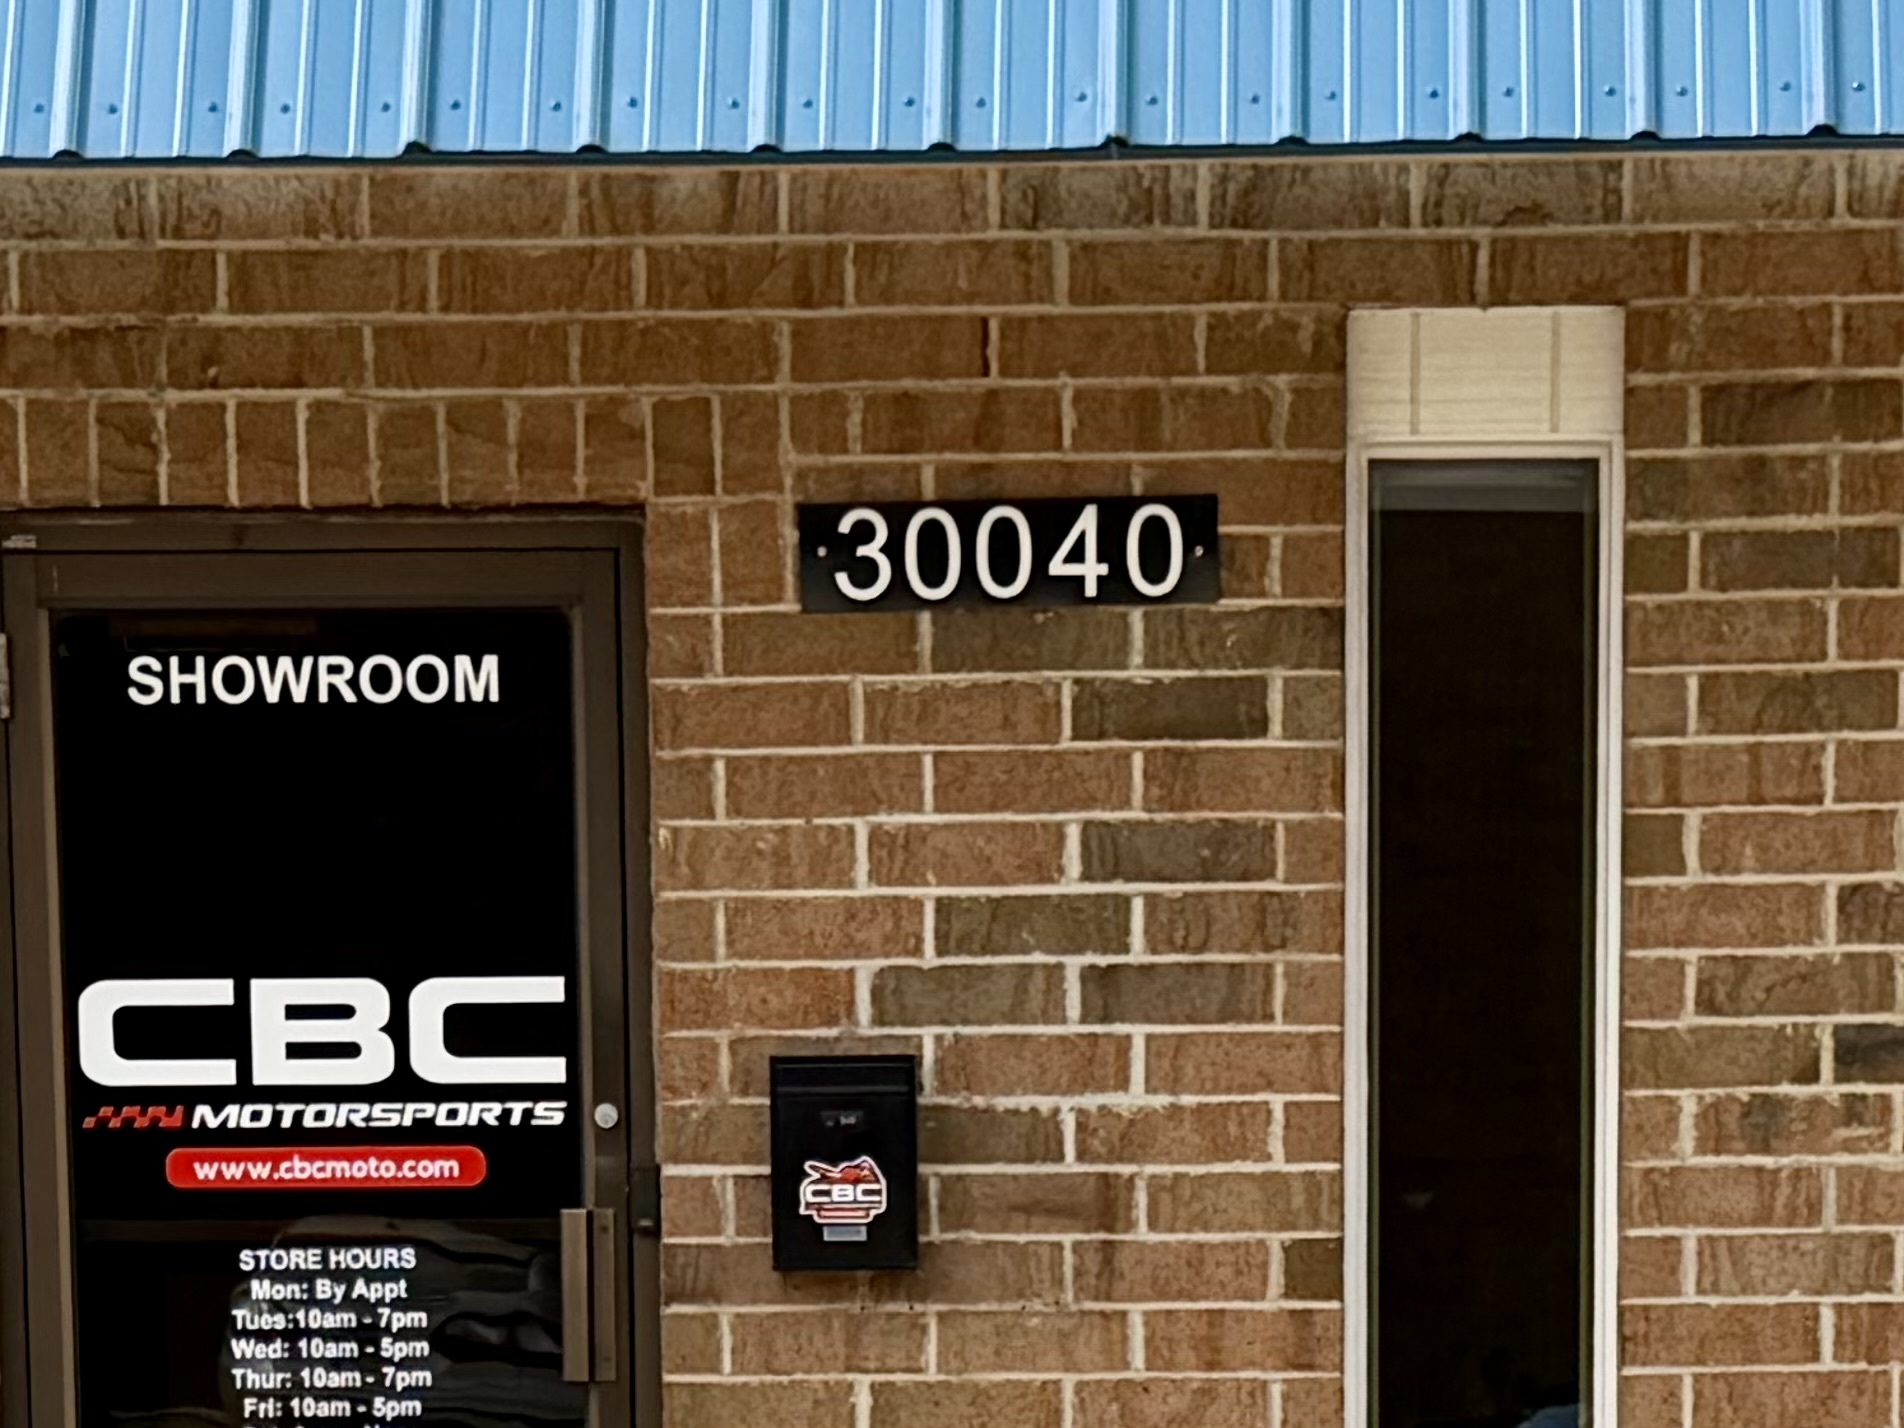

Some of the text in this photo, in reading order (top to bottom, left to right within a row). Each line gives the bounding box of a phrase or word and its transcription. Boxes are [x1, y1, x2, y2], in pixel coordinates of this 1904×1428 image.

[834, 504, 1184, 601] 30040
[127, 654, 500, 706] SHOWROOM
[77, 975, 567, 1087] CBC
[191, 1101, 568, 1129] MOTORSPORTS
[193, 1154, 460, 1181] www.cbcmoto.com
[805, 1183, 882, 1203] CBC
[239, 1247, 417, 1272] STORE HOURS
[250, 1278, 408, 1305] Mon: By Appt
[377, 1307, 428, 1333] 7pm
[230, 1338, 290, 1360] Wed:
[298, 1337, 359, 1359] 10am
[380, 1337, 430, 1363] 5pm
[231, 1367, 292, 1390] Thur:
[300, 1366, 362, 1389] 10am
[381, 1367, 433, 1393] 7pm
[243, 1397, 283, 1419] Fri:
[289, 1396, 351, 1418] 10am
[372, 1396, 423, 1422] 5pm
